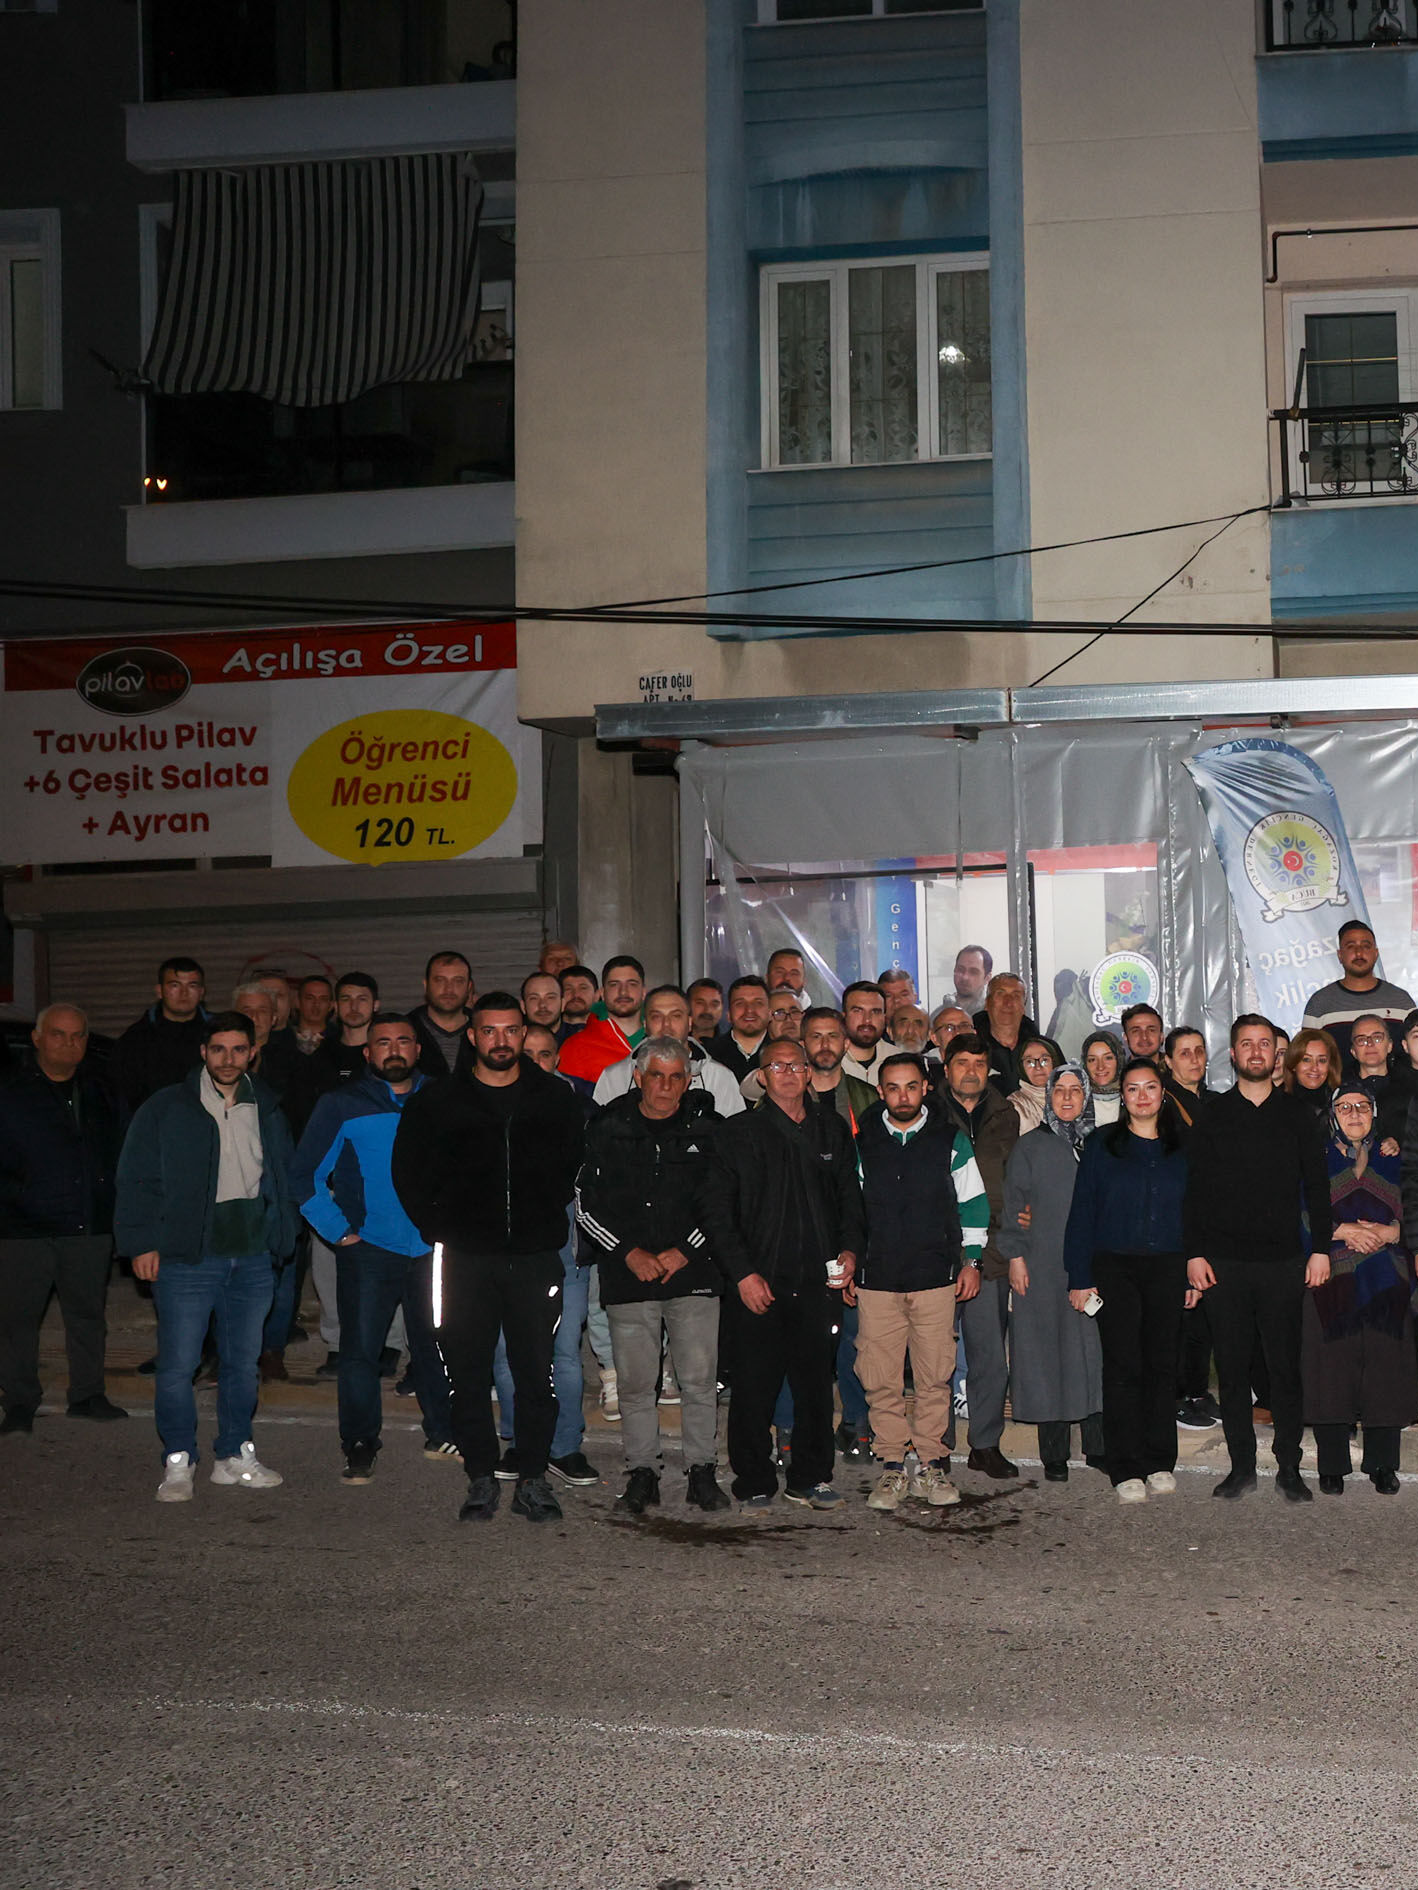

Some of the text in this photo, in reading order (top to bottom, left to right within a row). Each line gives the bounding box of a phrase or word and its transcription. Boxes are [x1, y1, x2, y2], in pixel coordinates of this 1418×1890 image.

[221, 633, 483, 678] Açılışa Özel
[639, 673, 692, 690] CAFER OĞLU
[33, 721, 258, 755] Tavuklu Pilav
[339, 731, 471, 771] Öğrenci
[23, 761, 270, 801] +6 Çeşit Salata
[331, 770, 472, 808] Menüsü
[107, 809, 210, 843] Ayran
[354, 816, 456, 849] 120 TL.
